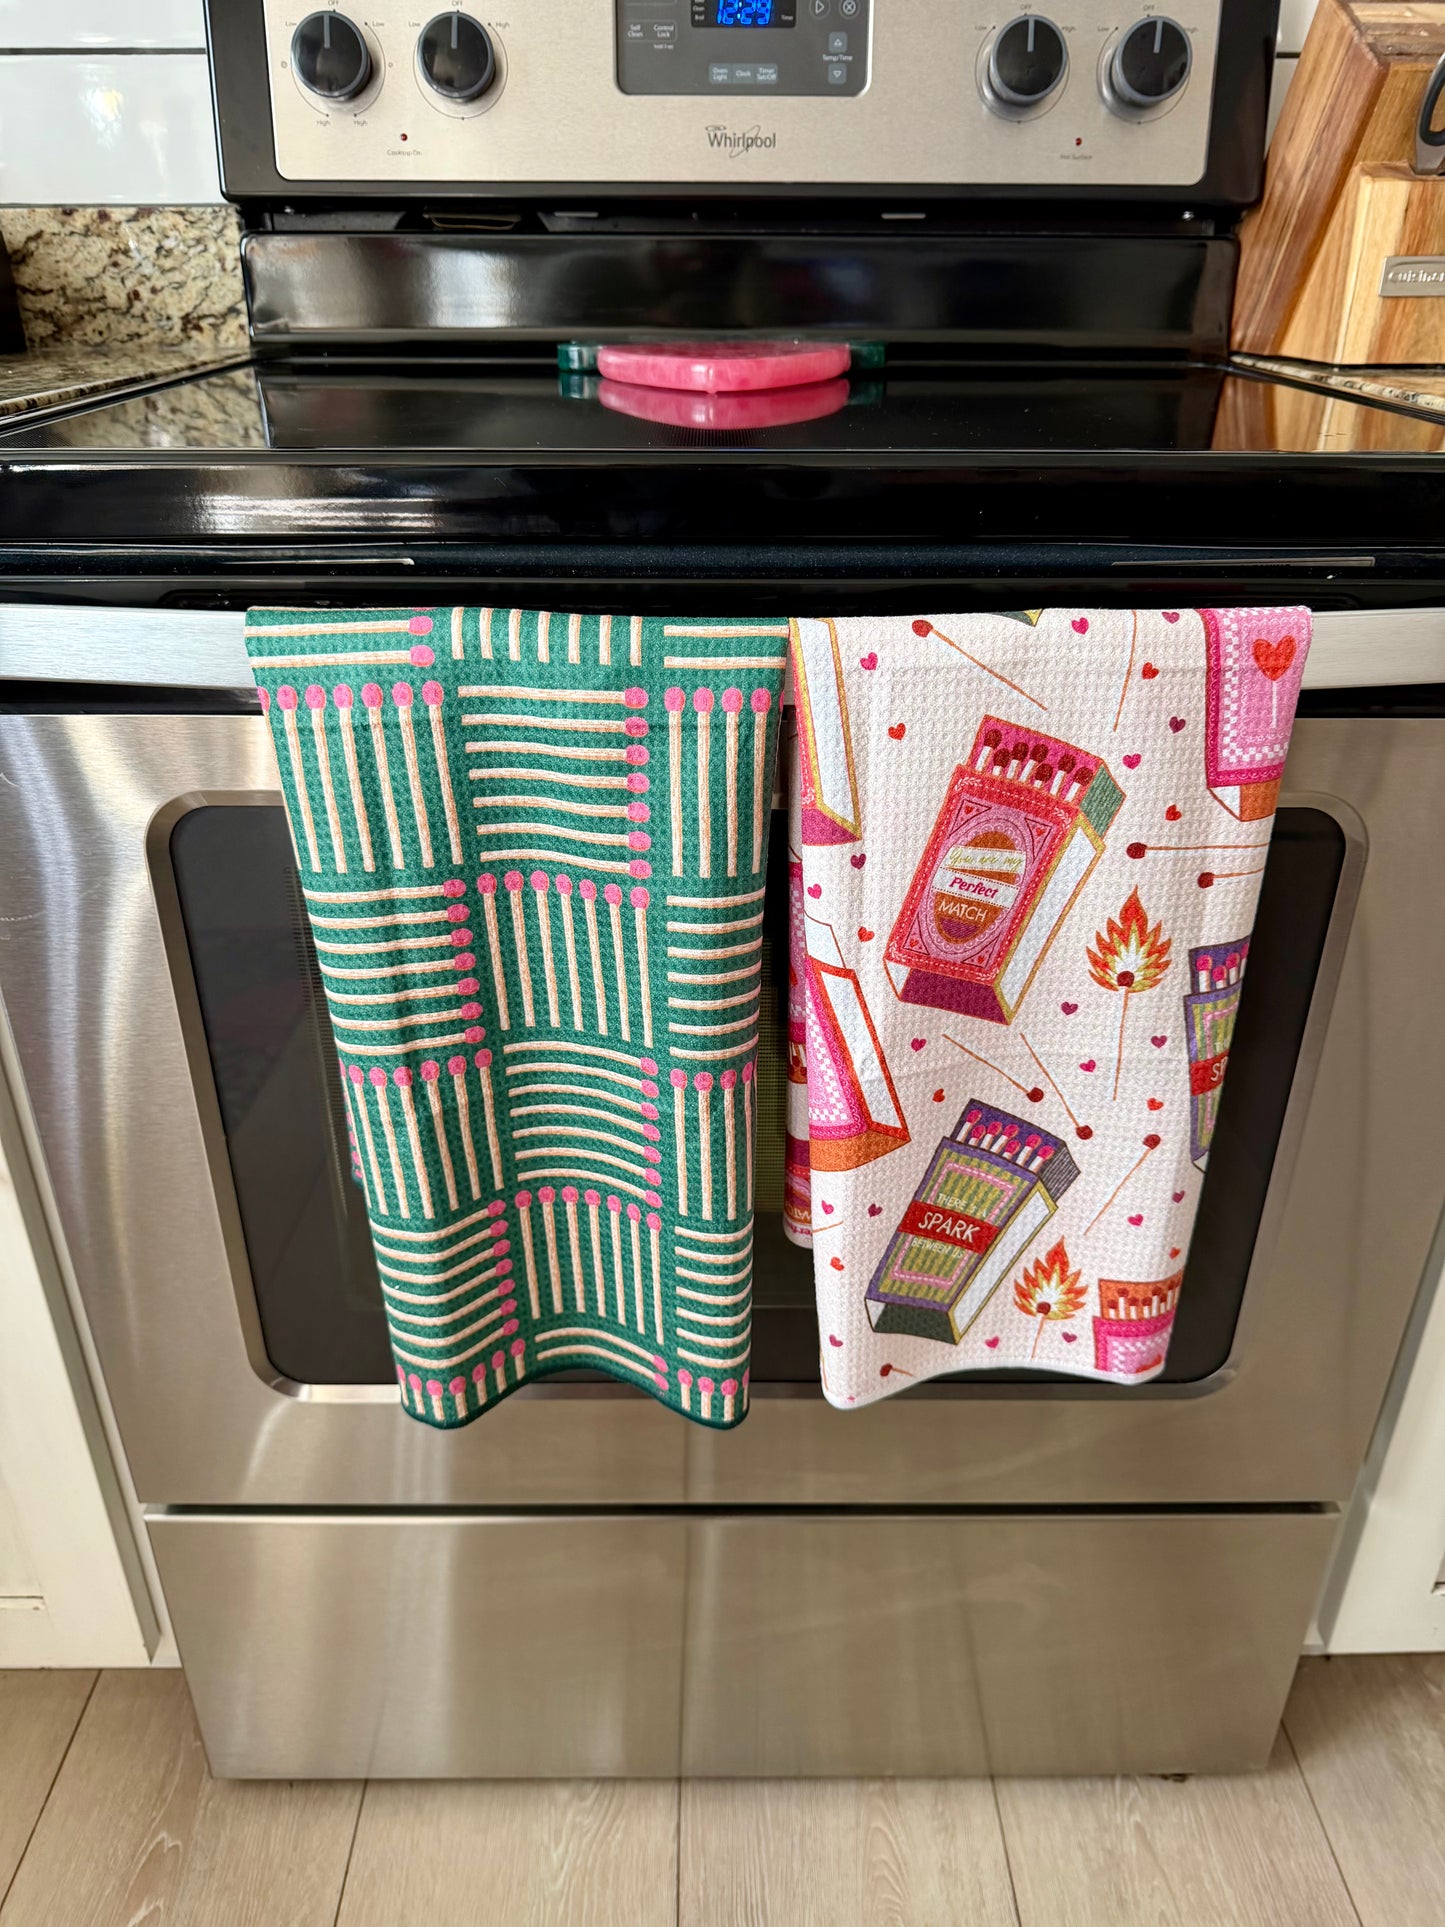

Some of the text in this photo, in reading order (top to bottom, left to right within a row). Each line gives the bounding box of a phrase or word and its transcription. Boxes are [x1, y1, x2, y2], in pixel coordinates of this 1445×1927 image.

[707, 131, 776, 152] Whirlpool
[948, 847, 1023, 873] You are my
[949, 876, 999, 899] Perfect
[938, 898, 989, 923] MATCH
[937, 1192, 969, 1211] THERE
[918, 1211, 981, 1243] SPARK
[911, 1236, 952, 1255] BETWEEN
